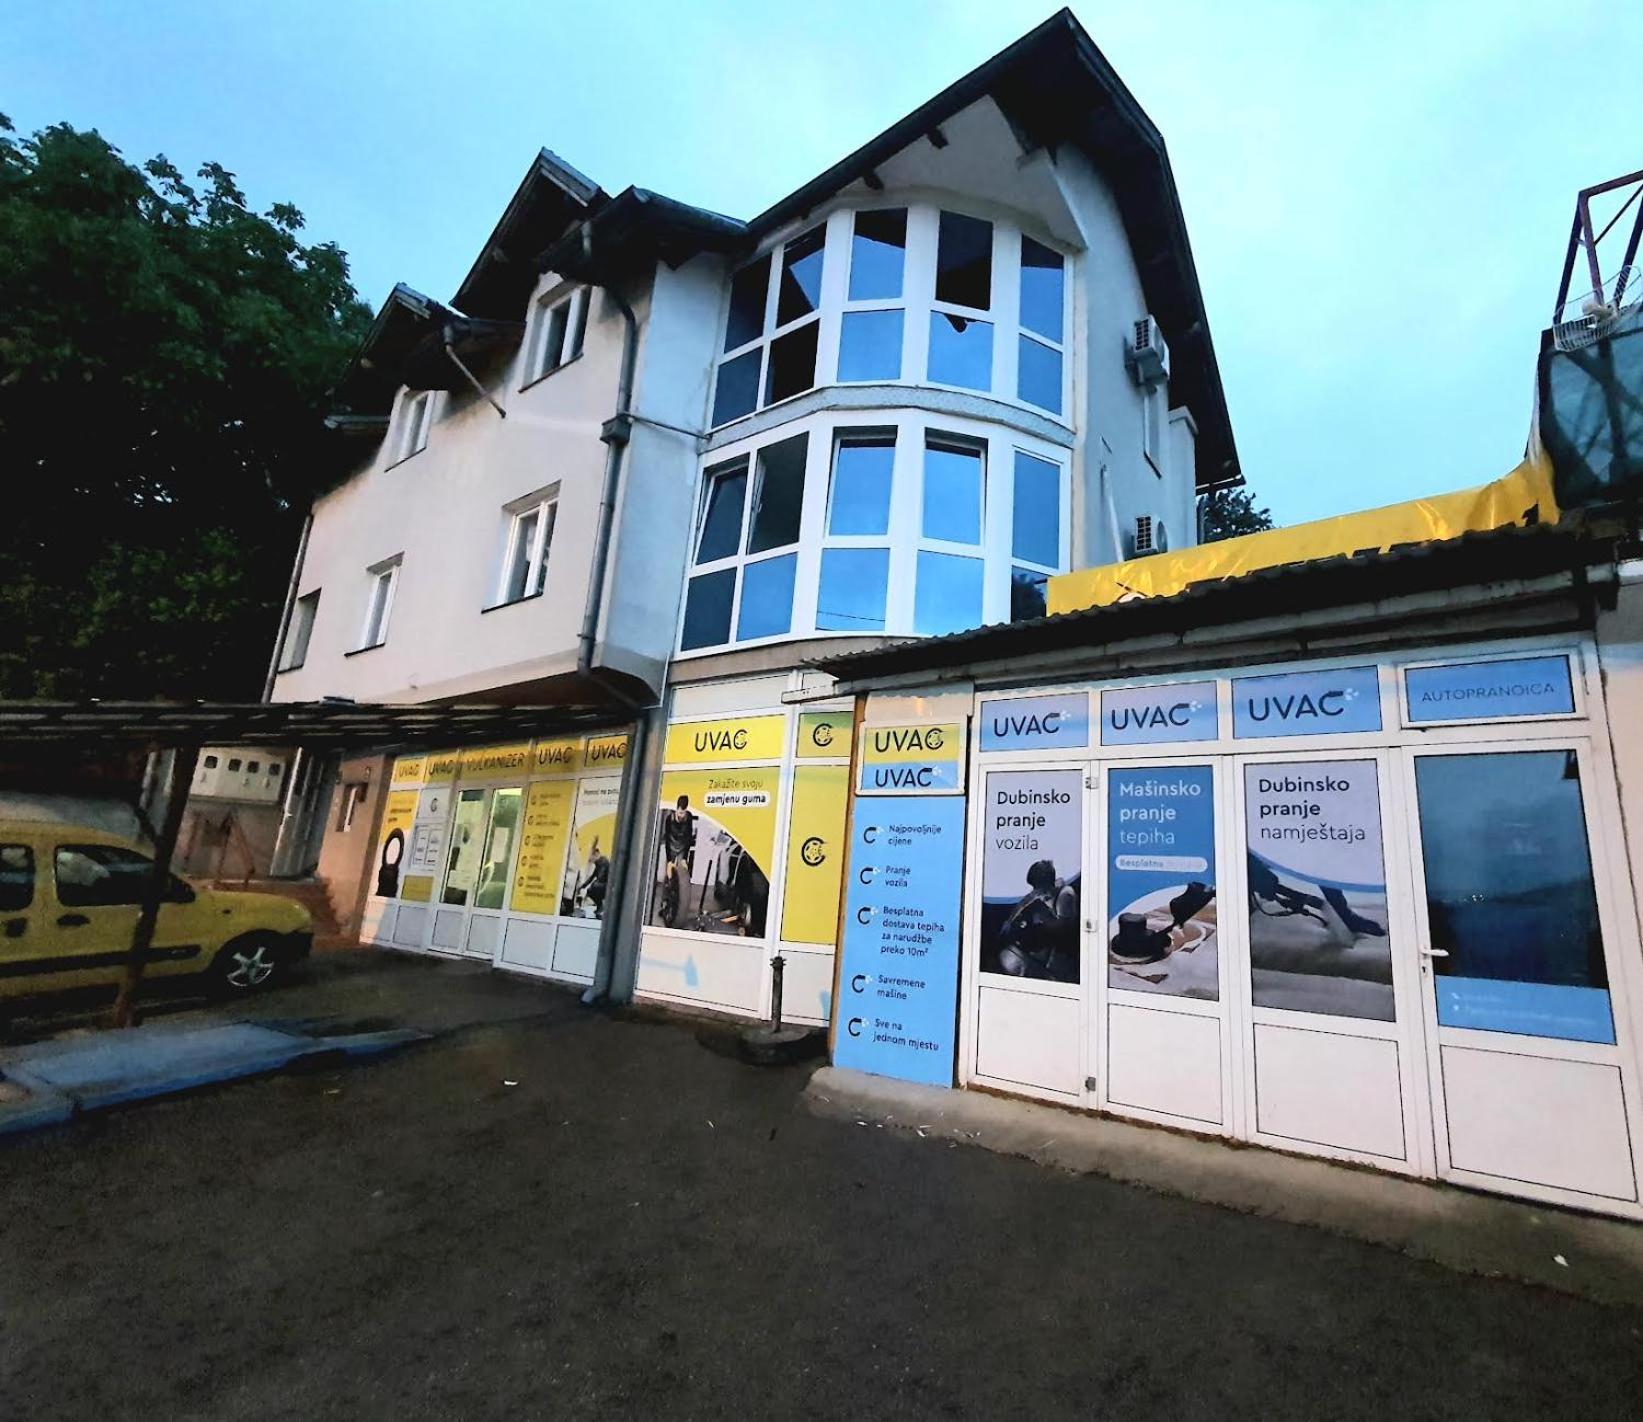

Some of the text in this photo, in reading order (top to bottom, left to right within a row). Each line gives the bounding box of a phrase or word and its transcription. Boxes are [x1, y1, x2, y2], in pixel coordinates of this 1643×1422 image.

[1248, 690, 1345, 721] UVAC
[1111, 702, 1190, 730] UVAC
[993, 712, 1061, 737] UVAC
[694, 729, 748, 752] UVAC
[875, 728, 944, 753] UVAC
[875, 767, 933, 787] UVAC
[1259, 776, 1350, 793] Dubinsko
[1119, 779, 1201, 797] Mašinsko
[706, 793, 766, 806] zamjenu guma
[997, 789, 1071, 805] Dubinsko
[1119, 804, 1177, 823] pranje
[1260, 800, 1321, 819] pranje
[996, 812, 1046, 830] pranje
[889, 824, 941, 835] Najpovoljnije
[1119, 828, 1176, 846] tepiha
[1261, 823, 1366, 844] namještaja
[888, 837, 912, 847] cijene
[995, 835, 1039, 850] vozila
[885, 865, 911, 876] Pranje
[885, 878, 908, 887] vozila
[883, 906, 924, 919] Besplatna
[882, 919, 945, 933] dostava tepiha
[893, 933, 933, 944] narudžbe
[880, 945, 905, 955] preko
[878, 974, 926, 989] Savremene
[877, 989, 907, 1000] mašine
[874, 1018, 902, 1031] Sve na
[872, 1031, 939, 1051] jednom mjestu
